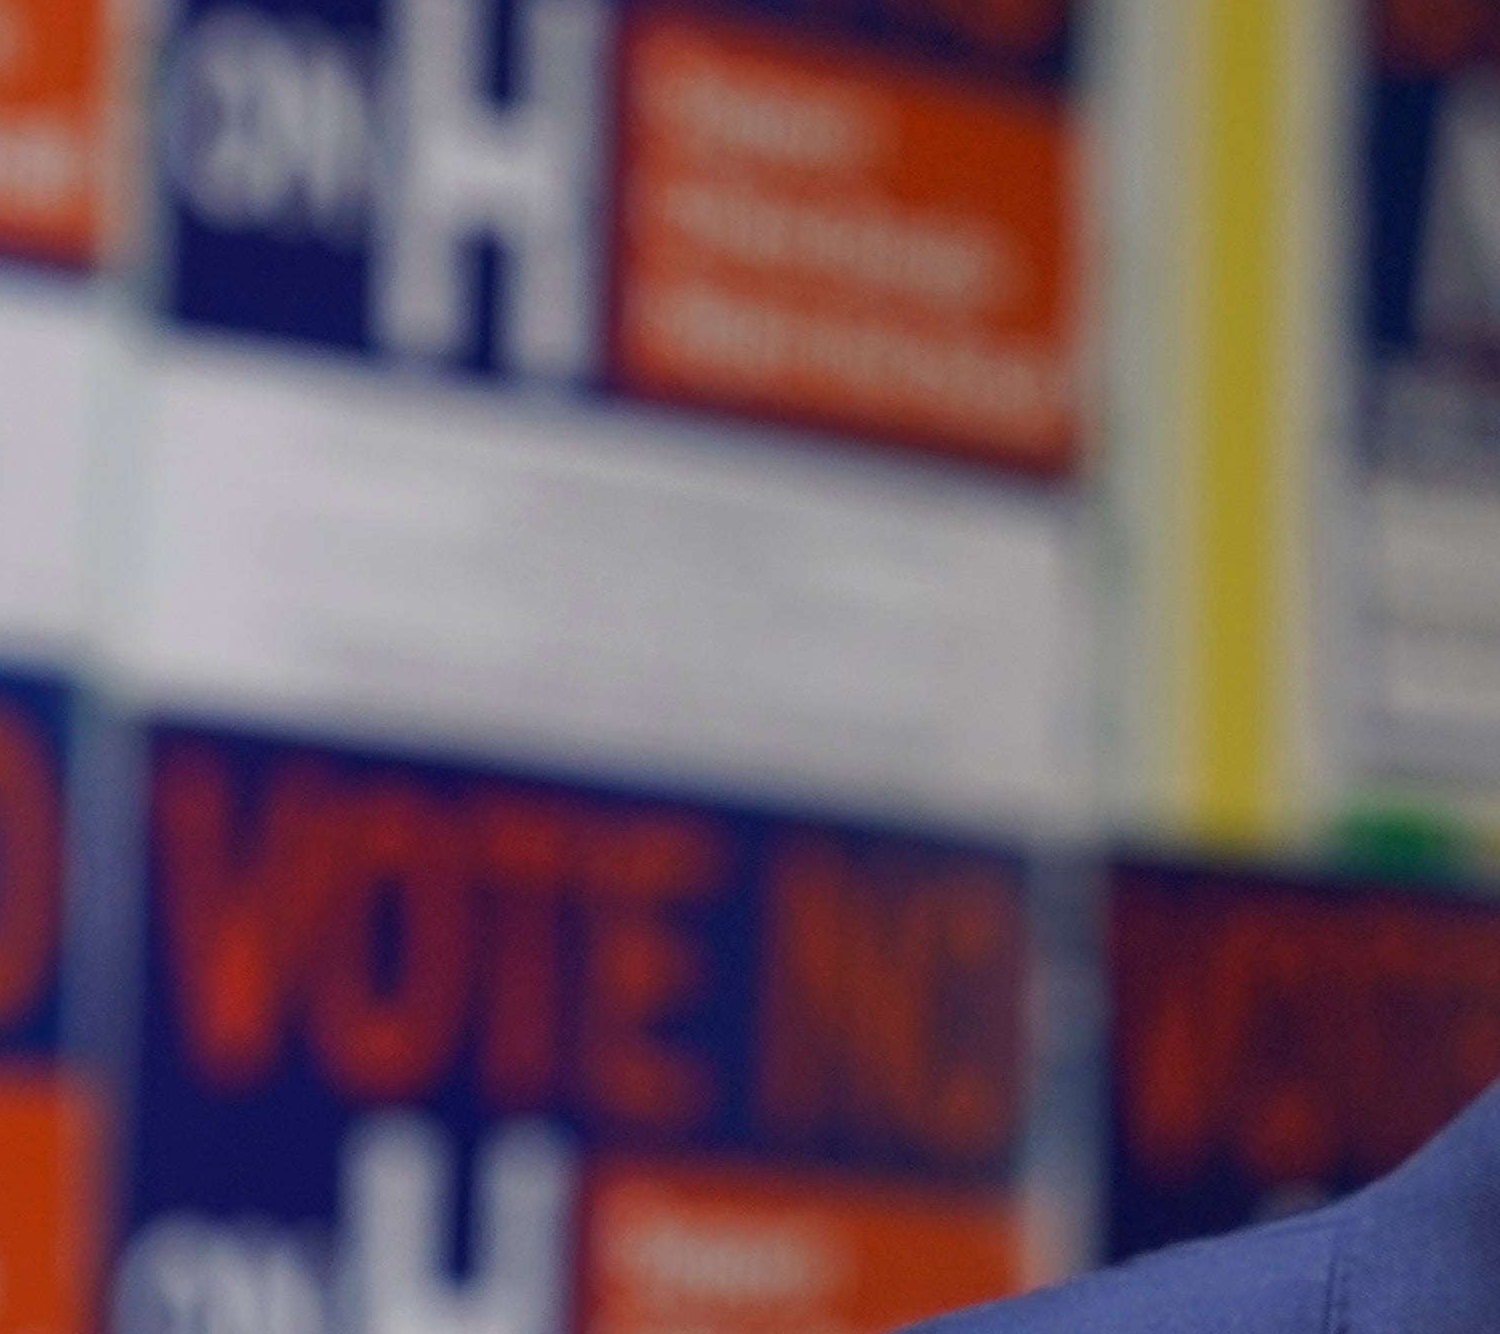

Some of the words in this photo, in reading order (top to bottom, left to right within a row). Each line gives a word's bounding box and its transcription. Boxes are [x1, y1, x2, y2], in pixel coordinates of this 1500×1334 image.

[171, 1, 373, 242] ON
[153, 741, 731, 1135] VOTE
[755, 827, 1024, 1163] NO
